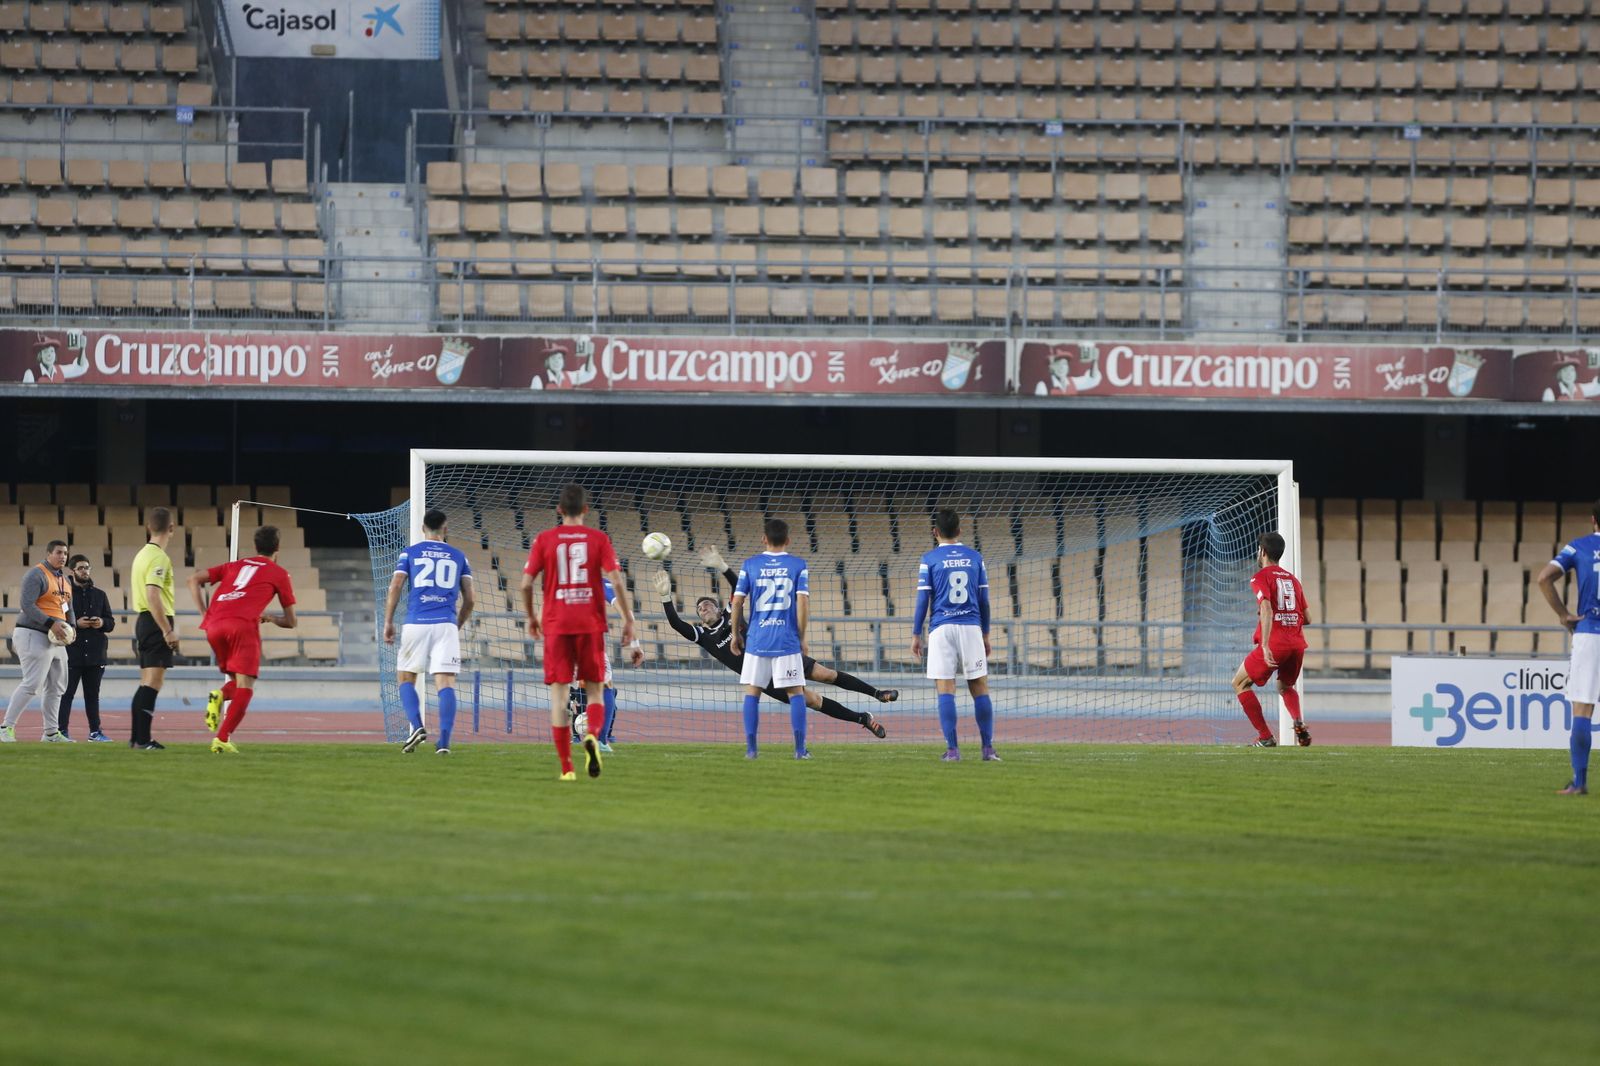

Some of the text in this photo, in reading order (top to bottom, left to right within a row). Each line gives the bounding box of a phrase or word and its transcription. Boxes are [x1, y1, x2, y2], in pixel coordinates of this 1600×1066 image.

[243, 4, 336, 36] Cajasol
[177, 111, 193, 121] 240
[95, 333, 307, 383] Cruzcampo
[322, 345, 339, 378] SIN
[416, 354, 437, 371] CD
[602, 340, 813, 389] Cruzcampo
[828, 351, 845, 384] SIN
[922, 359, 942, 376] CD
[1106, 345, 1318, 395] Cruzcampo
[1333, 357, 1350, 390] SIN
[1429, 366, 1449, 383] CD
[420, 550, 451, 560] XEREZ
[556, 541, 589, 585] 12
[943, 558, 972, 569] XEREZ
[413, 557, 458, 589] 20
[760, 567, 789, 577] XEREZ
[948, 570, 969, 604] 8
[755, 577, 794, 612] 23
[1503, 668, 1570, 690] clínic
